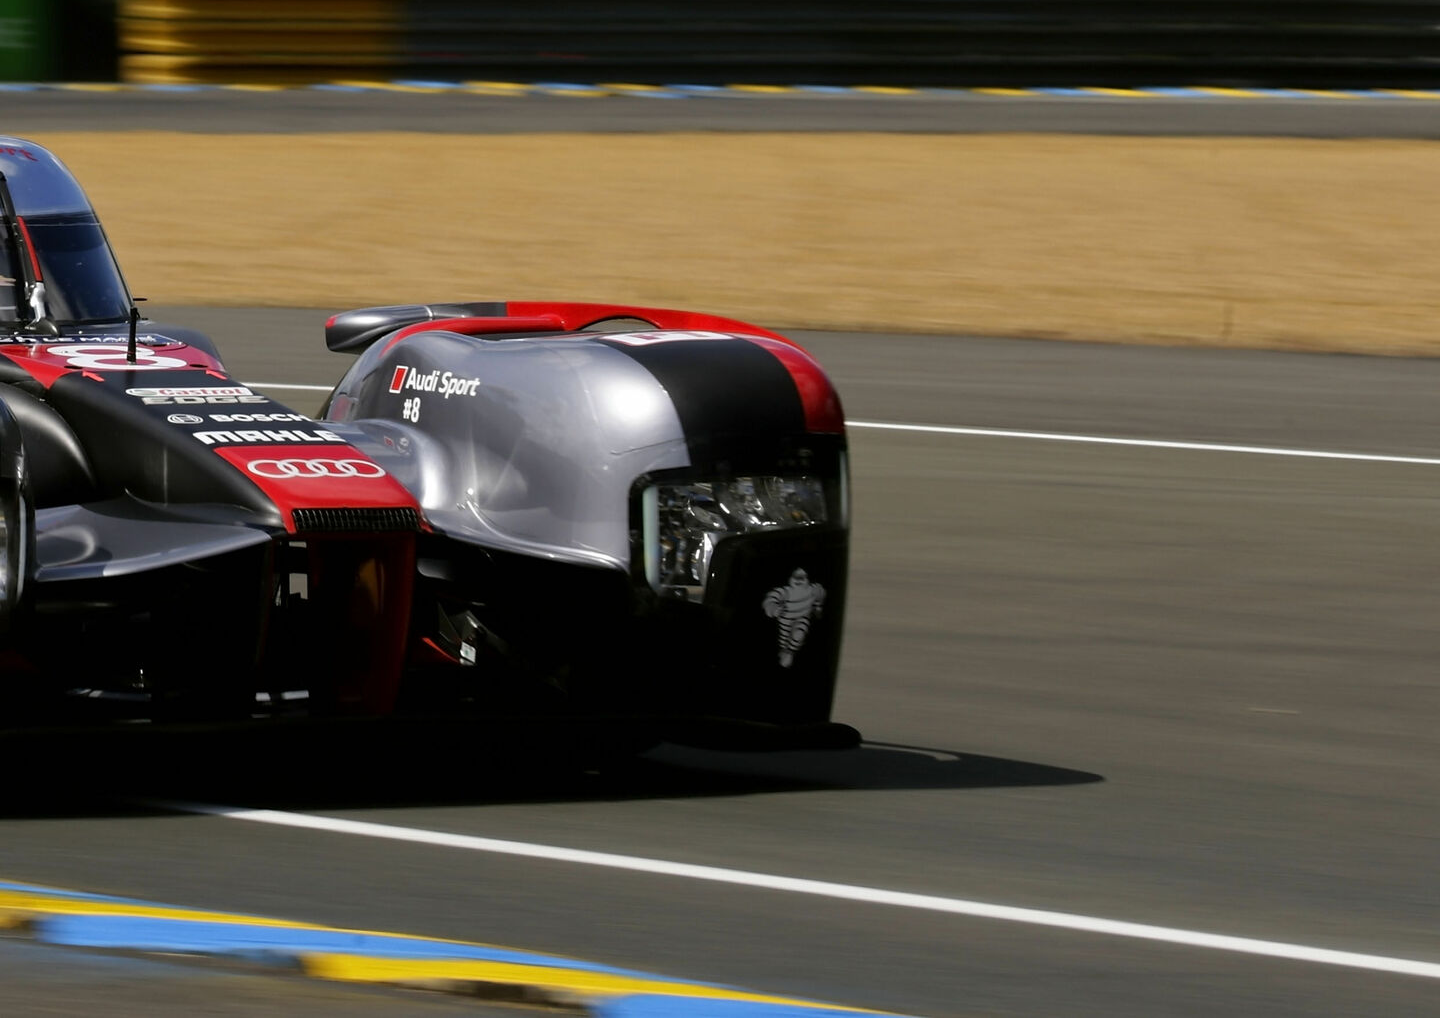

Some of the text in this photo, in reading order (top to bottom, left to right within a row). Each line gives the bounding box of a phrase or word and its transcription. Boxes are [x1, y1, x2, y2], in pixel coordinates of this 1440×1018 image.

[46, 345, 188, 370] 8
[405, 367, 481, 399] Audi Sport
[158, 387, 245, 397] Castrol
[141, 395, 270, 406] EDGE
[208, 413, 314, 423] BOSCH
[402, 397, 421, 423] #8
[192, 430, 347, 446] MAHLE
